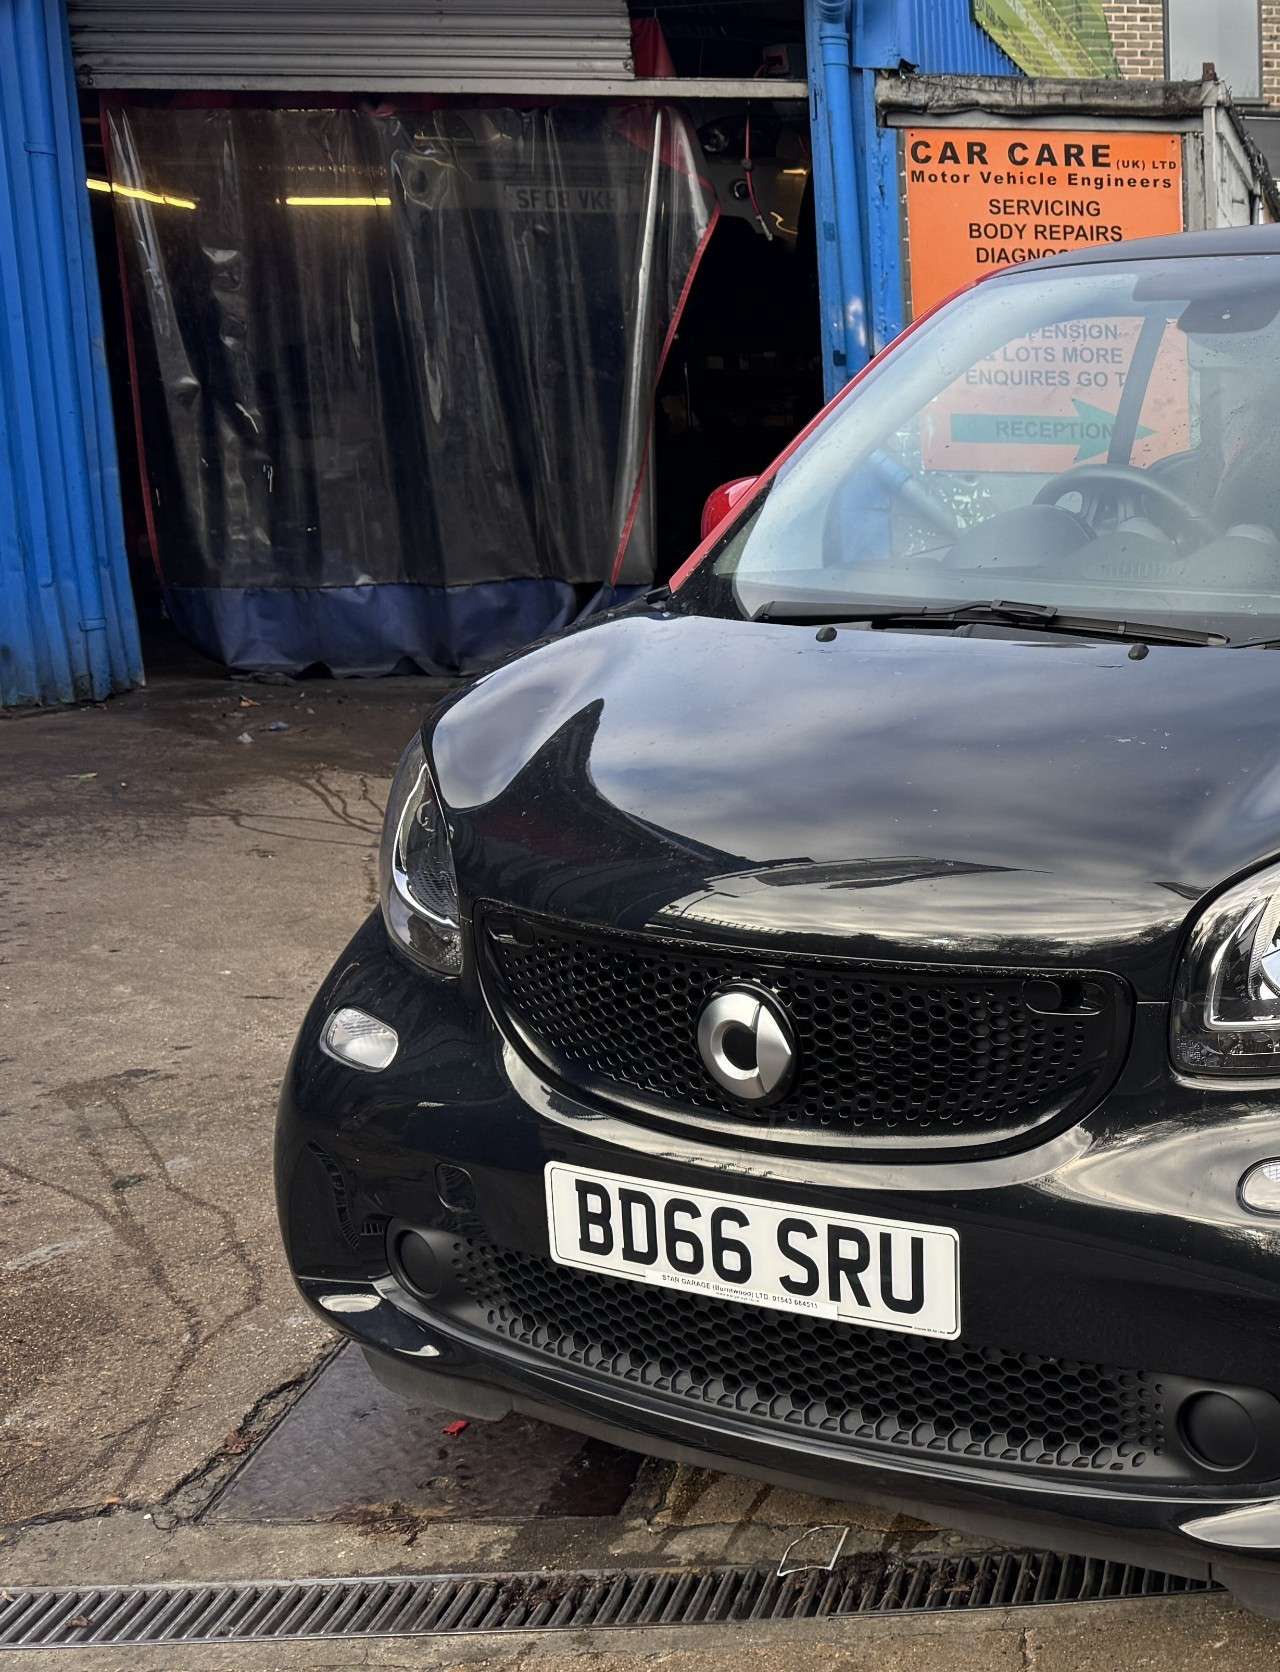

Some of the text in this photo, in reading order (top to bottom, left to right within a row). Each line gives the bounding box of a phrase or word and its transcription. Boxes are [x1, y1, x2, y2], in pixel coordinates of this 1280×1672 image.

[910, 140, 1177, 171] CAR CARE (UK) LTD
[911, 170, 1172, 190] Motor Vehicle Engineers
[988, 199, 1101, 217] SERVICING
[968, 223, 1123, 242] BODY REPAIRS
[976, 247, 1069, 264] DIAGNO
[1003, 346, 1056, 363] LOTS
[1063, 347, 1123, 364] MORE
[965, 369, 1070, 386] ENQUIRES
[1077, 371, 1108, 387] GO
[574, 1177, 925, 1316] BD66 SRU
